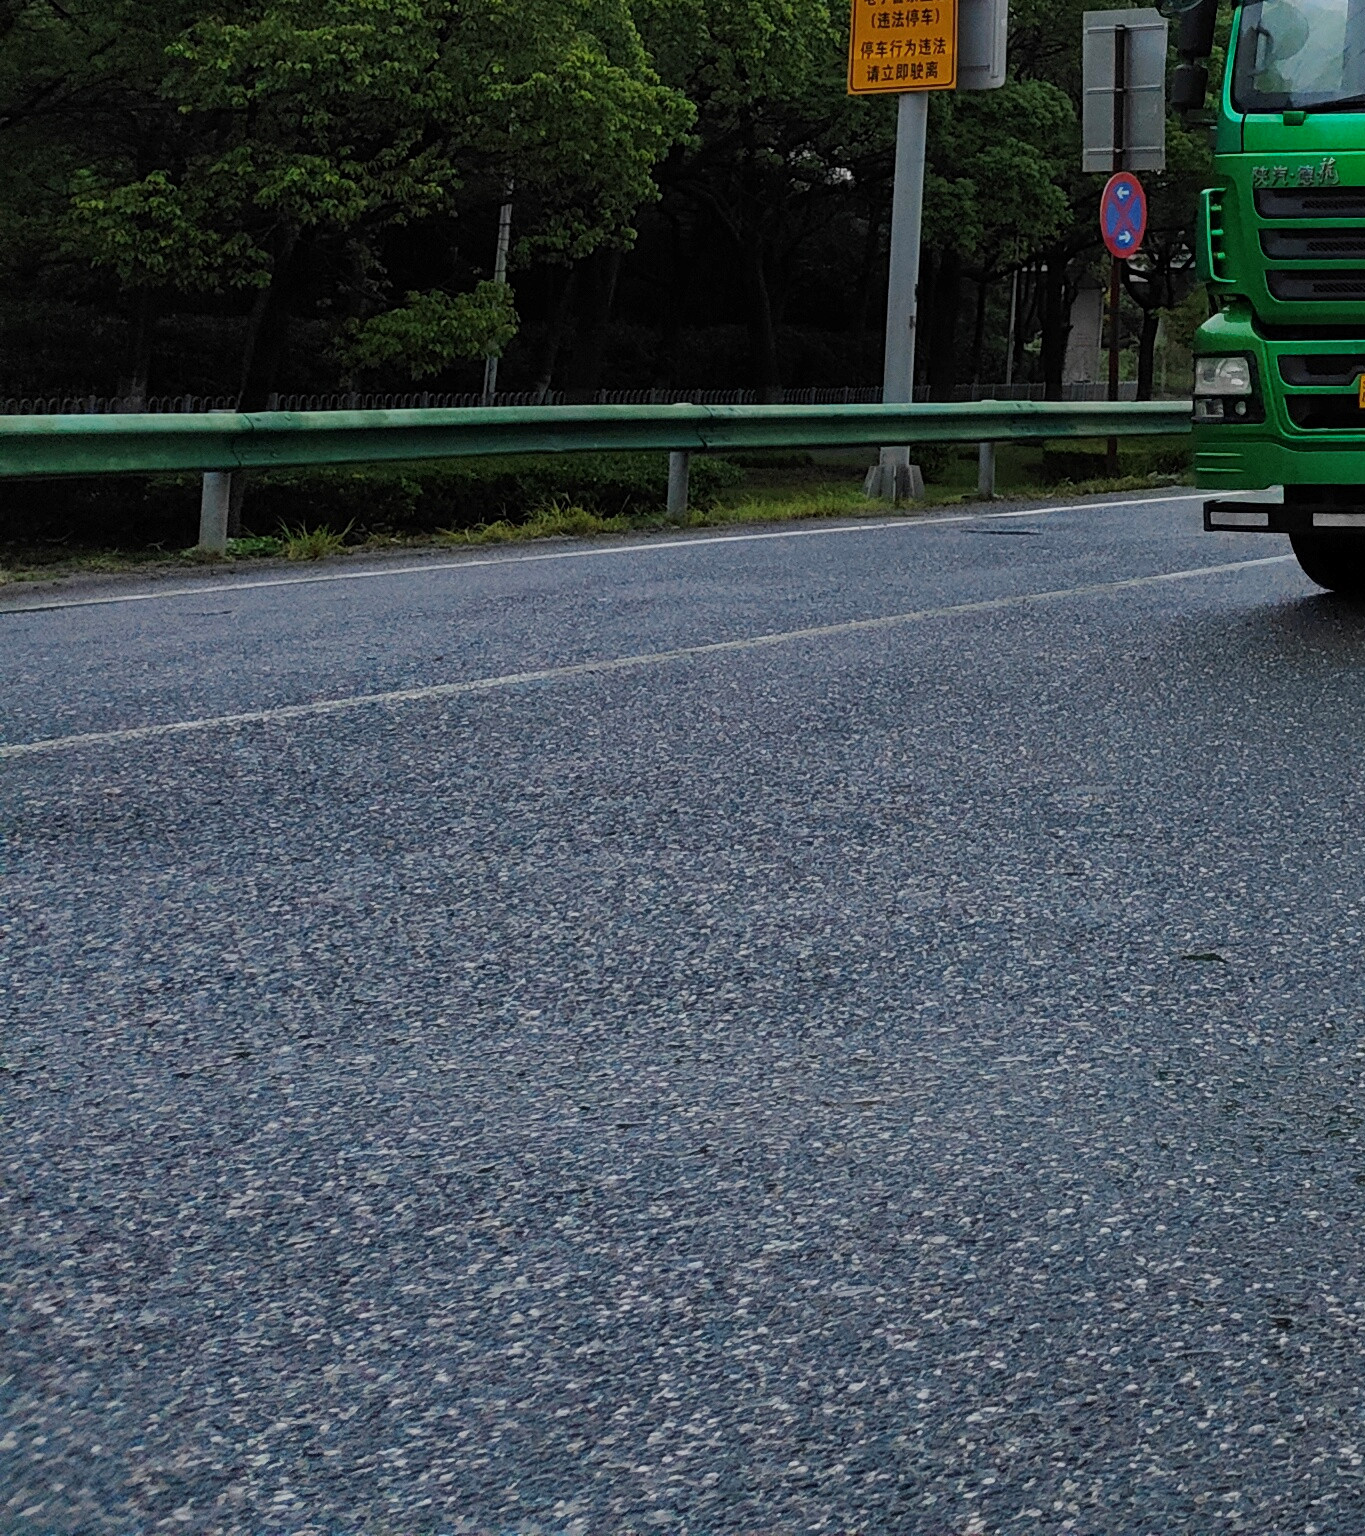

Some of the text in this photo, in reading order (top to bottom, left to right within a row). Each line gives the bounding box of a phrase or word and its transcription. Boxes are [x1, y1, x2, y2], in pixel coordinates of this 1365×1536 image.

[861, 37, 946, 60] 停车行为违法
[867, 61, 938, 83] 请立即驶离
